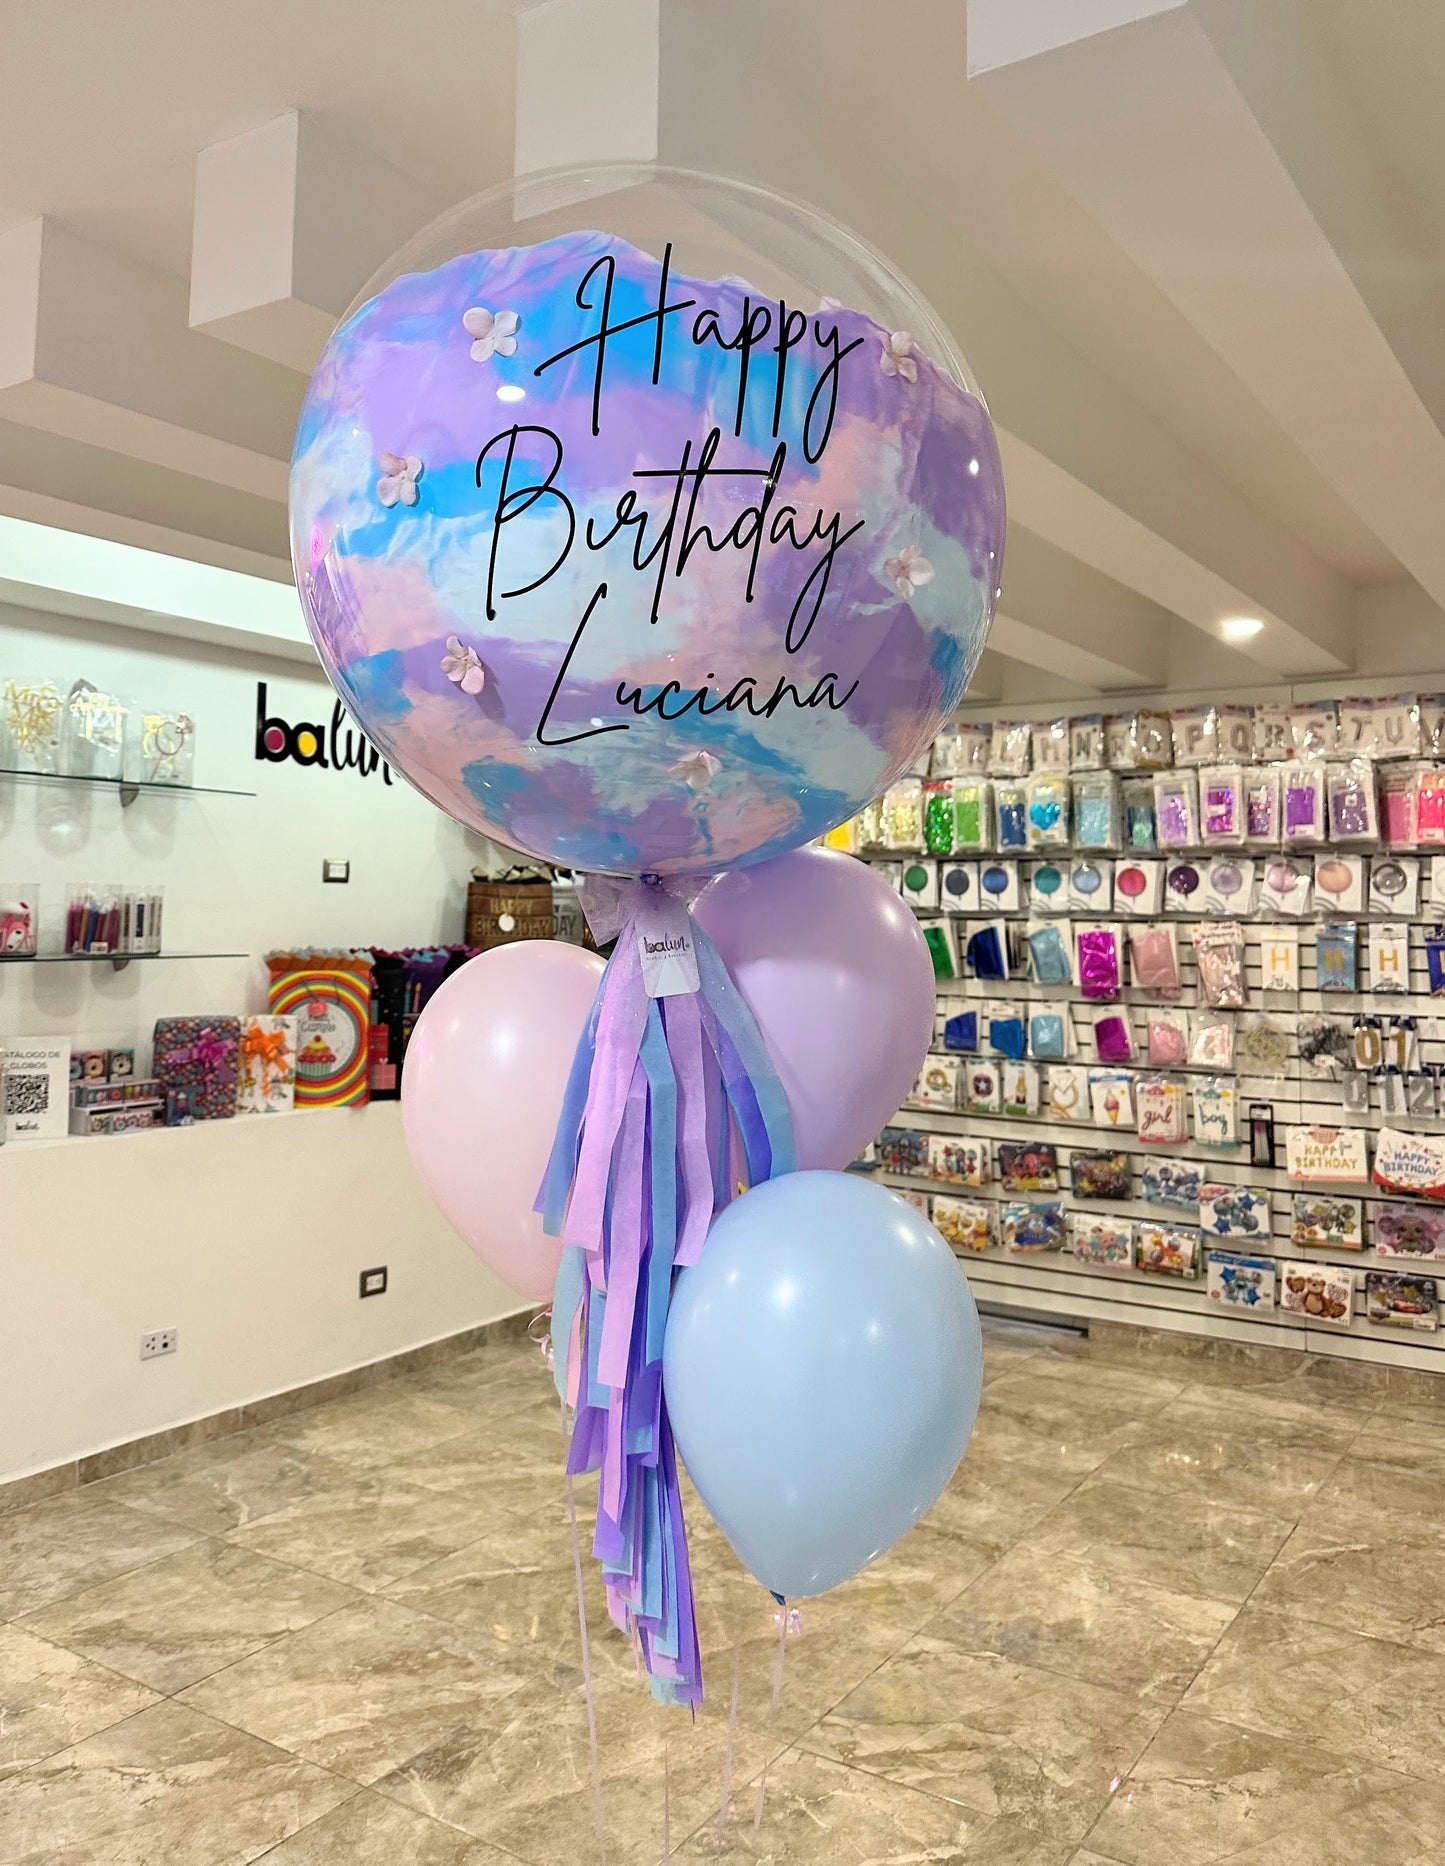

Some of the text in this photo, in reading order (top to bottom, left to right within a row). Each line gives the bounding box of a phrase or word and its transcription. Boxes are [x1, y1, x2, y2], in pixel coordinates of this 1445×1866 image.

[534, 243, 864, 464] Happy
[475, 424, 865, 653] Birthday
[536, 583, 860, 745] Luciana
[1230, 722, 1249, 754] Q
[1350, 715, 1372, 742] T
[475, 917, 551, 937] BIRHDAY
[1271, 947, 1290, 971] H
[1325, 949, 1344, 971] H
[1379, 948, 1398, 972] H
[48, 1050, 60, 1059] DE
[1391, 1029, 1406, 1068] 1
[1410, 1077, 1435, 1115] 2
[1142, 1104, 1172, 1130] girl
[1199, 1103, 1227, 1135] boy
[1295, 1156, 1358, 1169] BIRTHDAY
[1304, 1144, 1344, 1156] HAPPY
[1394, 1151, 1430, 1165] HAPPY
[1383, 1162, 1439, 1176] BIRTHDAY
